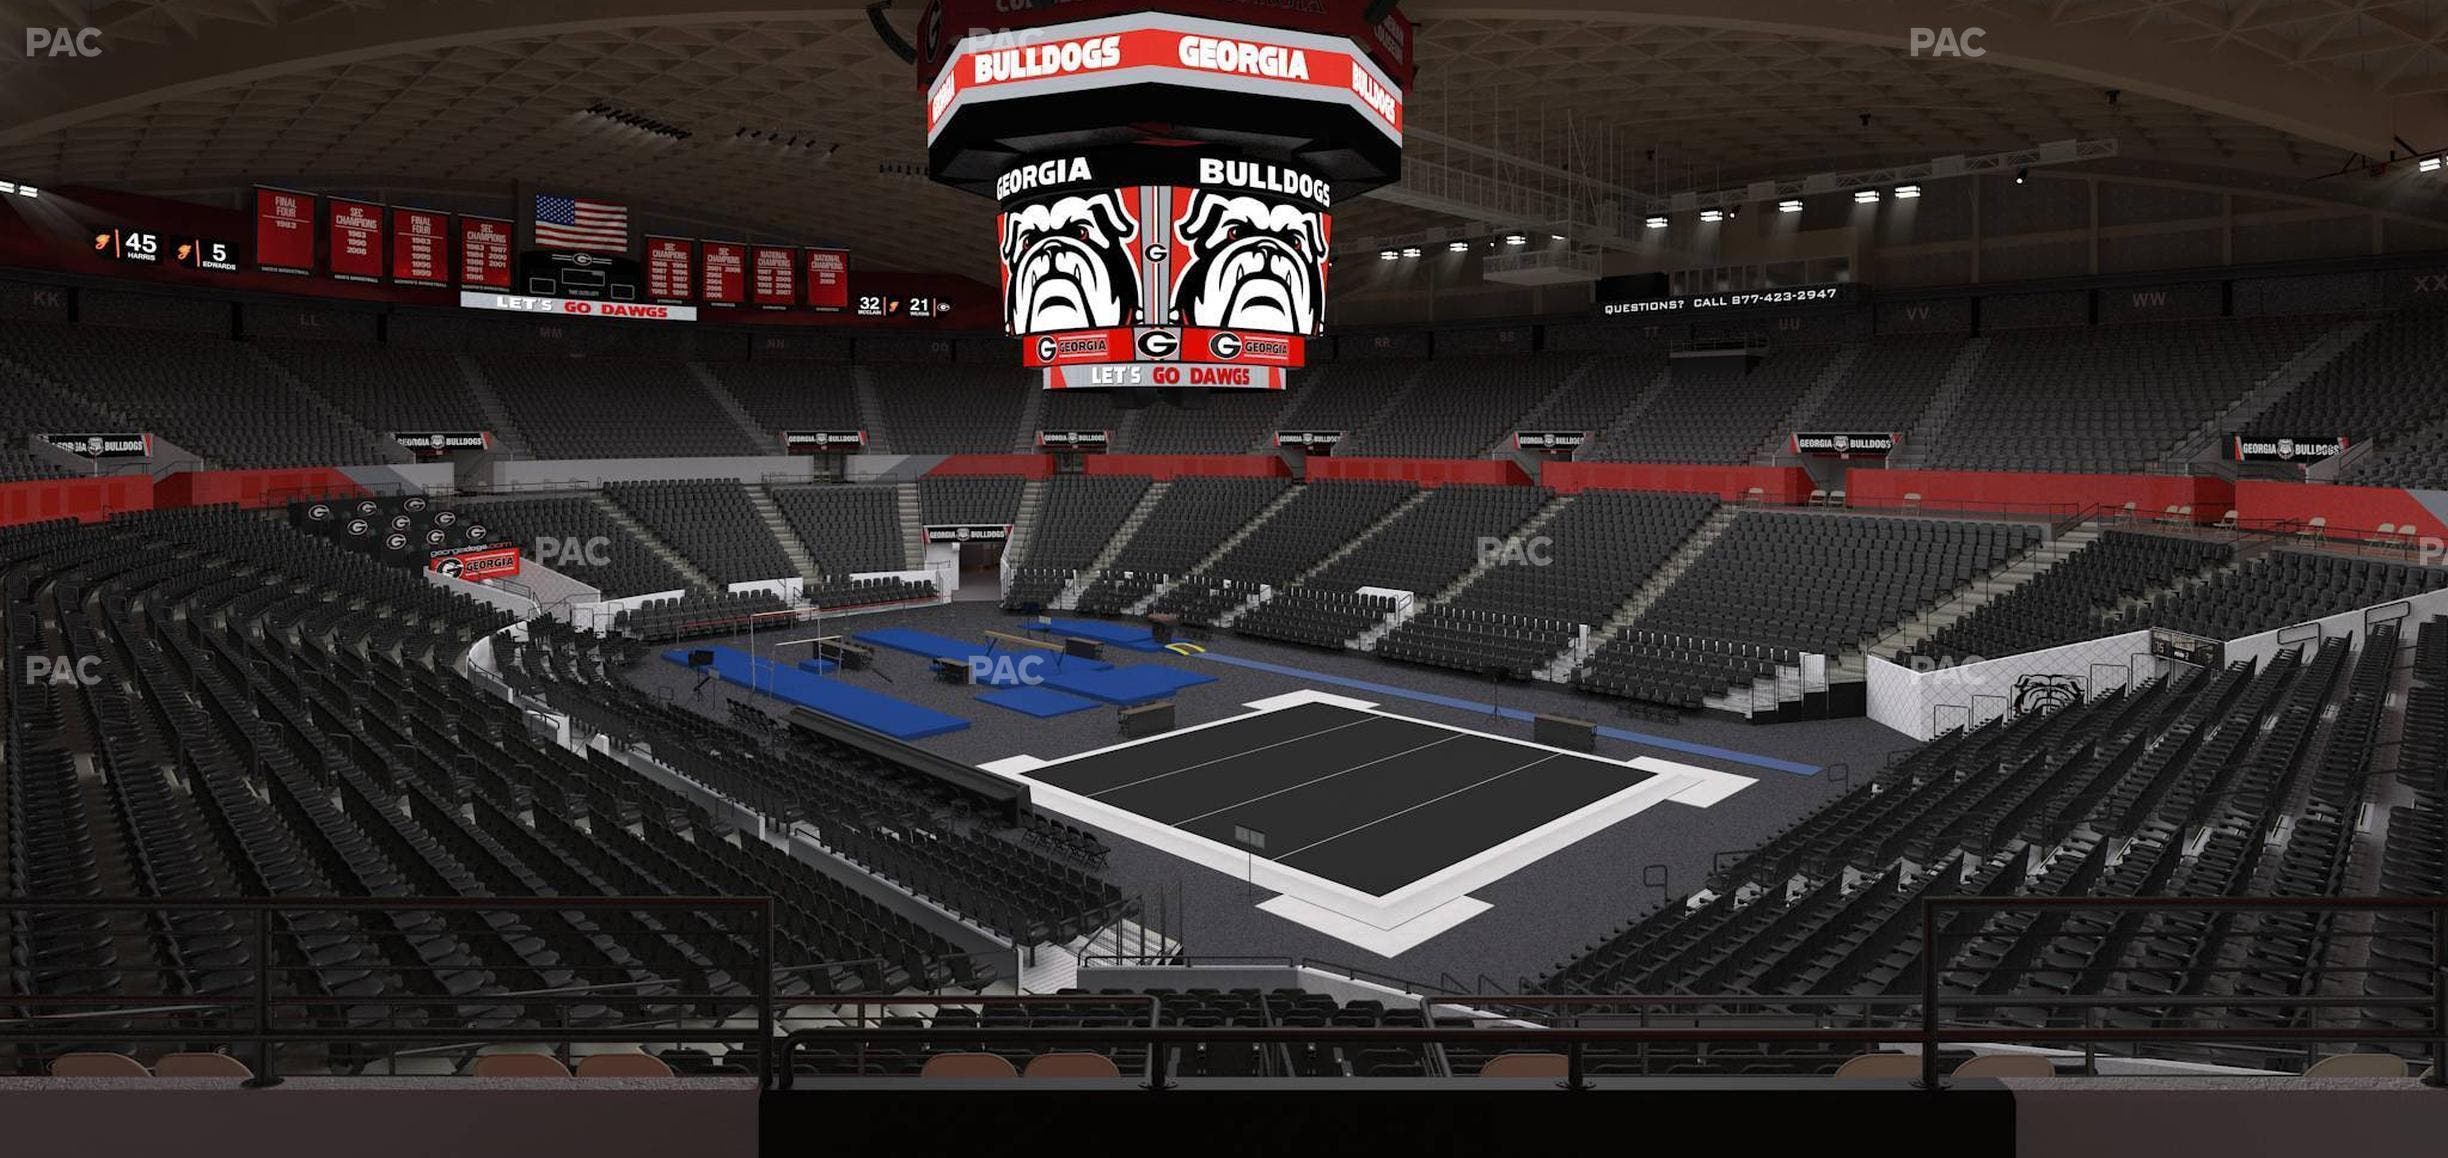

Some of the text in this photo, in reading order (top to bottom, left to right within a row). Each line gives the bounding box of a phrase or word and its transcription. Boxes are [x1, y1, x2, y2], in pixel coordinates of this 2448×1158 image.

[975, 36, 1121, 84] BULLDOGS
[1178, 35, 1310, 81] GEORGIA
[1352, 61, 1396, 125] BULLDOGS
[996, 157, 1331, 207] GEORGIA BULLDOGS
[275, 196, 297, 208] FINAL
[276, 207, 297, 218] FOUR
[336, 214, 378, 229] CHAMPIONS
[411, 215, 431, 226] FINAL
[125, 232, 157, 254] 45
[128, 251, 155, 261] HARRIS
[212, 243, 227, 262] 5
[1146, 245, 1167, 261] G
[202, 261, 236, 271] EDWARDS
[496, 295, 667, 318] LET'S GO DAWGS
[860, 296, 880, 310] 32
[910, 298, 928, 311] 21
[1605, 288, 1837, 315] QUESTIONS? CALL 877-423-2947
[2132, 291, 2167, 307] WW
[1905, 306, 1930, 320] VV
[1039, 337, 1107, 360] G GEORGIA
[1141, 332, 1178, 357] G
[1213, 333, 1288, 358] G GEORGIA
[1091, 366, 1250, 385] LET'S GO DAWGS
[104, 441, 143, 451] BULLDOGS
[446, 437, 481, 446] BULLDOGS
[1800, 439, 1892, 448] GEORGIA BULLDOGS
[2243, 443, 2277, 454] GEORGIA
[466, 557, 515, 572] GEORGIA
